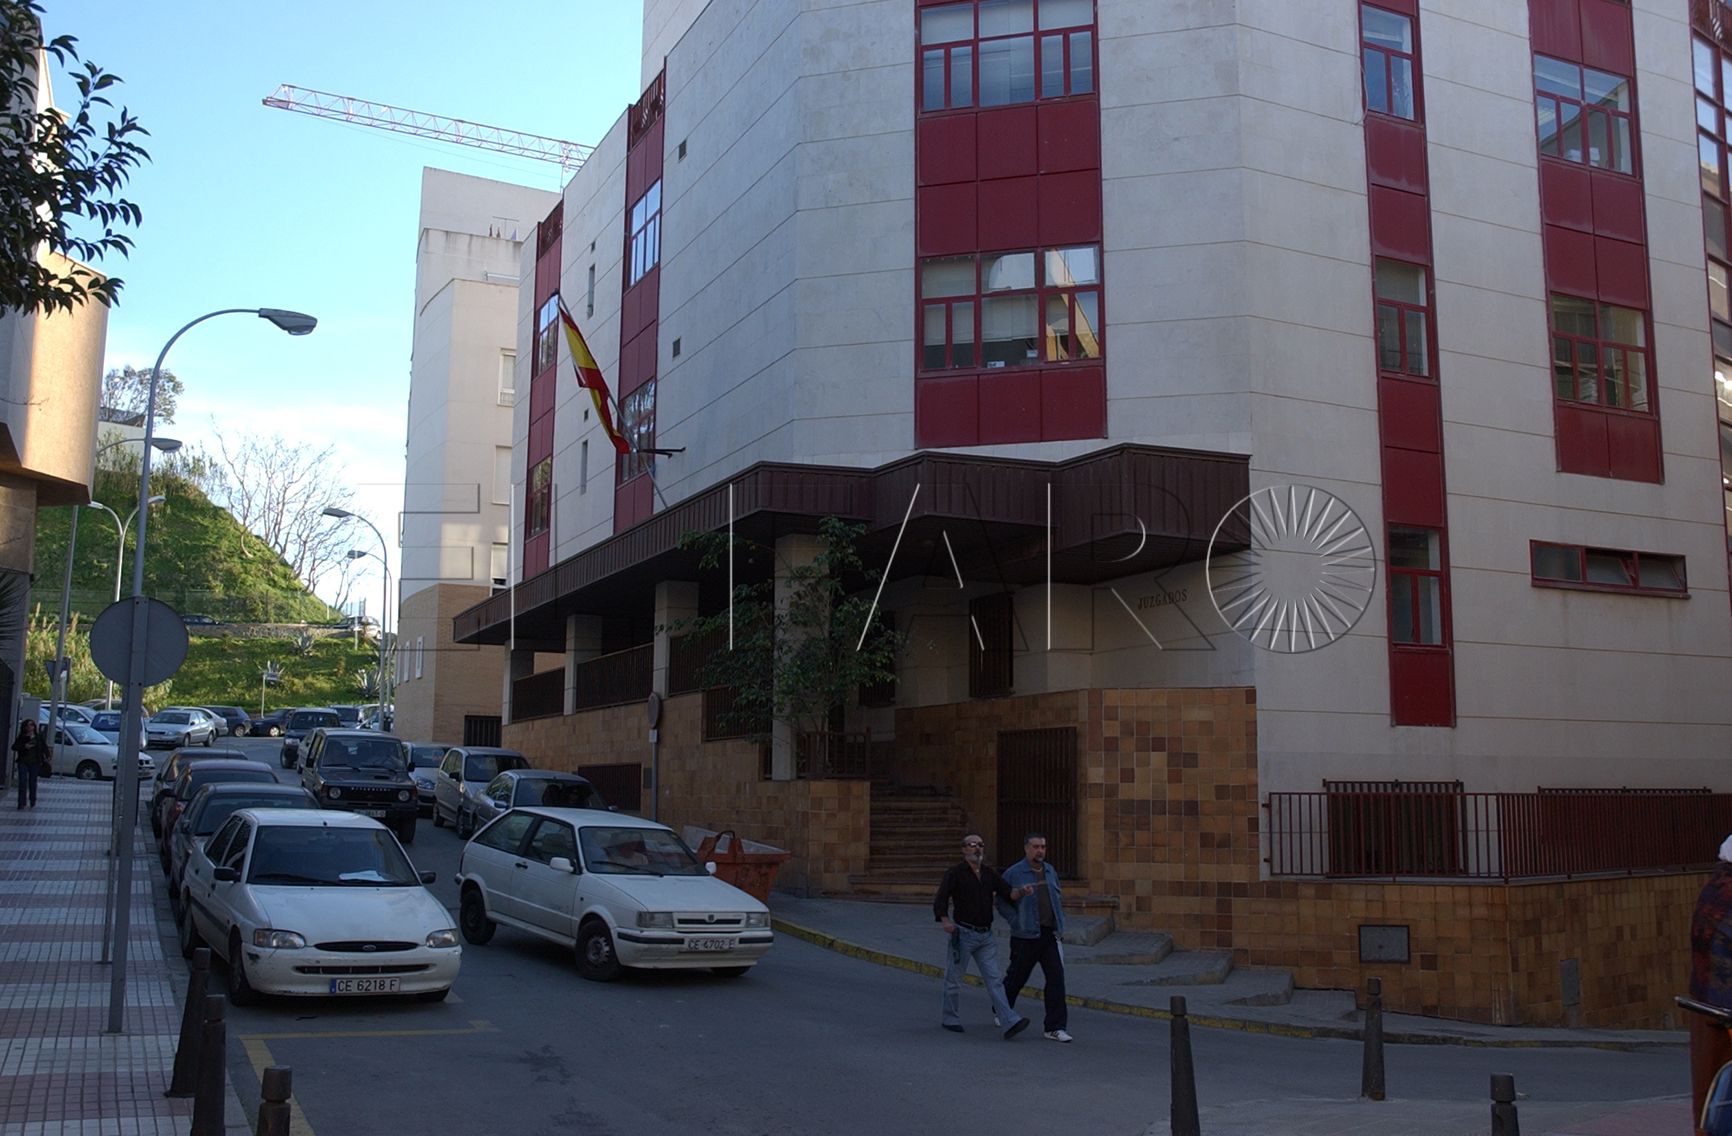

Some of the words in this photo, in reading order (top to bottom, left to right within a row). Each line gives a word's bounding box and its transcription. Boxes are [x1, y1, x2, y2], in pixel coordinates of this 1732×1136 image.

[1137, 588, 1188, 610] JUZGADOS
[337, 980, 353, 992] CE
[356, 979, 386, 992] 6218
[389, 979, 397, 991] F
